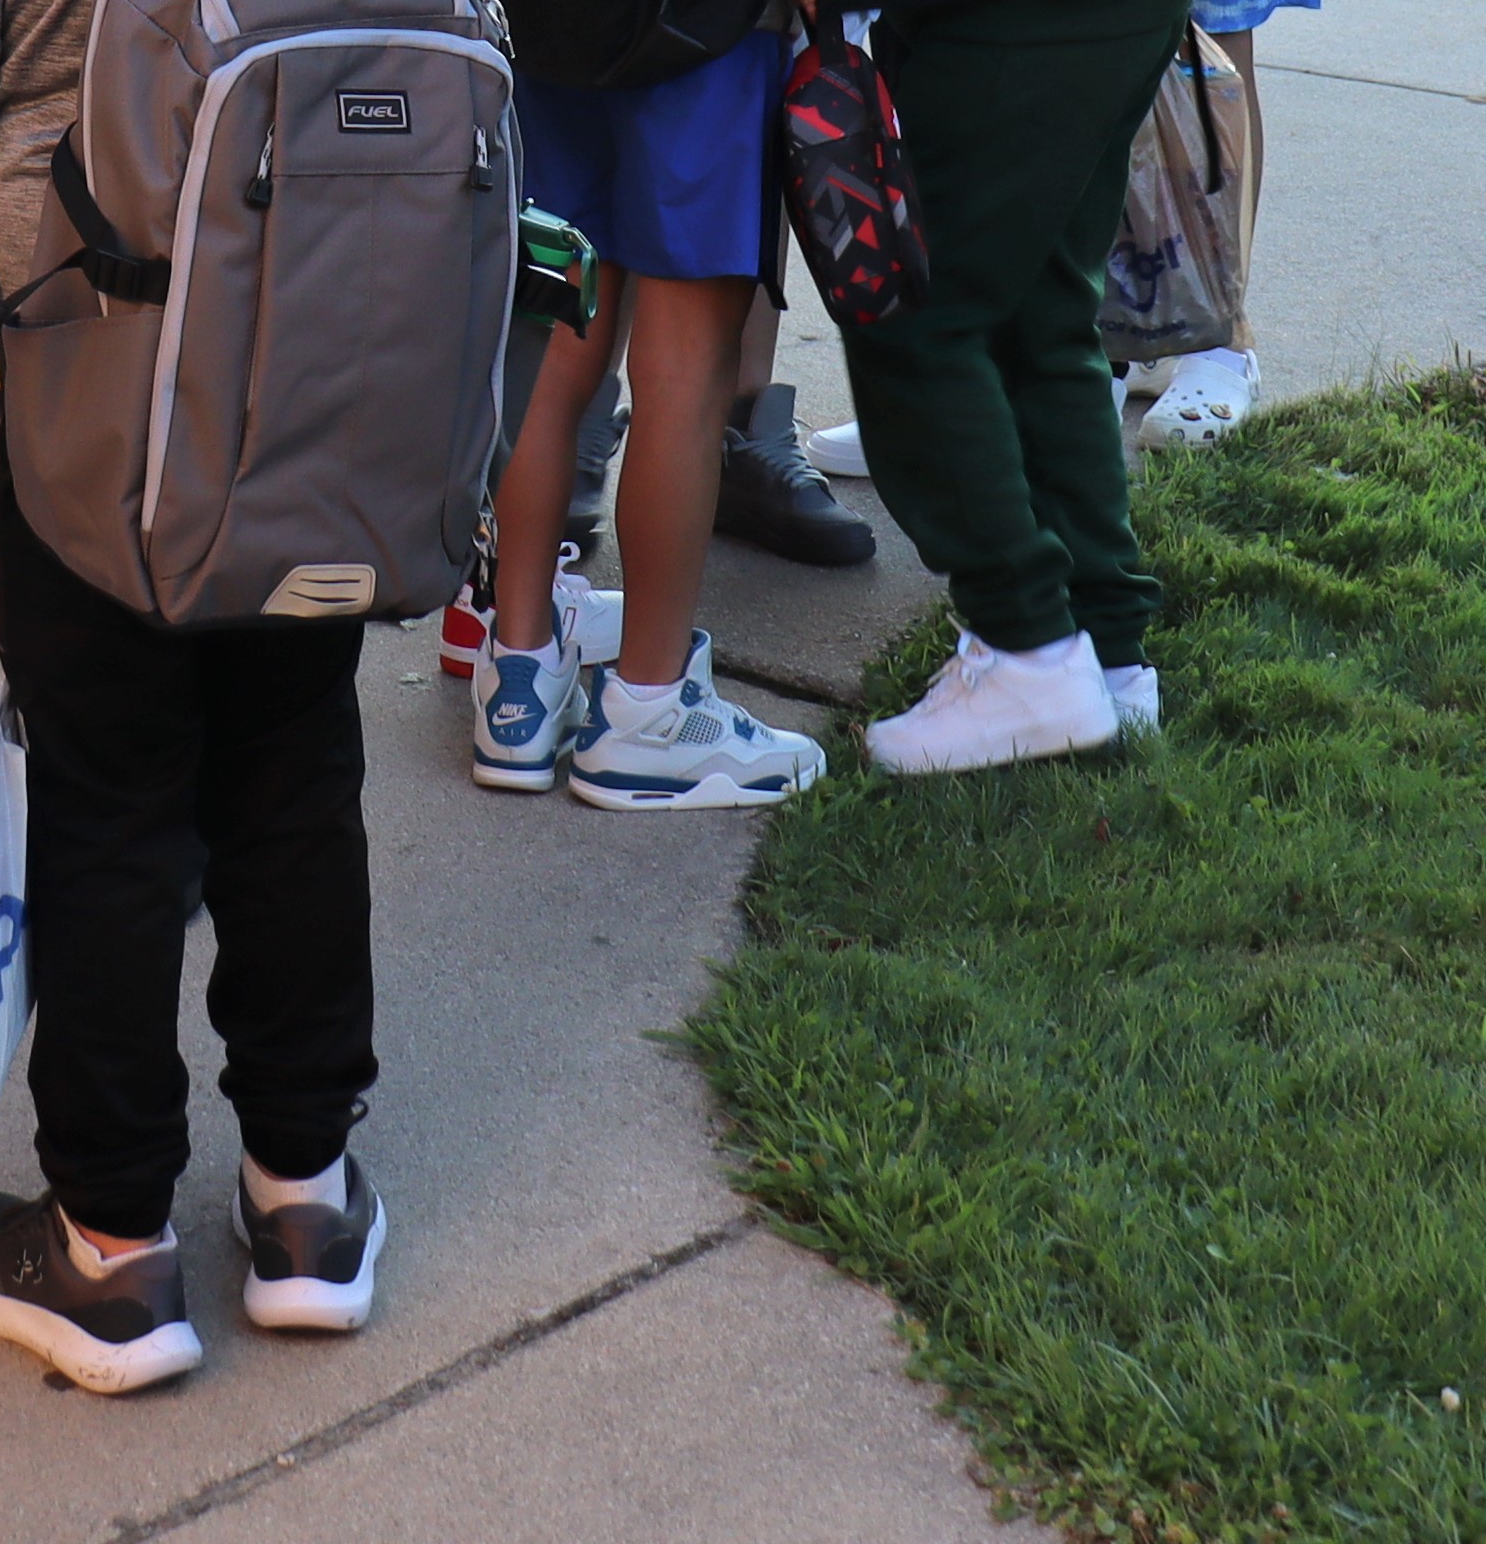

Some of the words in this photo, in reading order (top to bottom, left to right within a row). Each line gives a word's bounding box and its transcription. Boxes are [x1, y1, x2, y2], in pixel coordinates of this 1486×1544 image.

[347, 105, 399, 118] FUEL
[498, 702, 528, 716] NIKE
[498, 727, 527, 738] AIR
